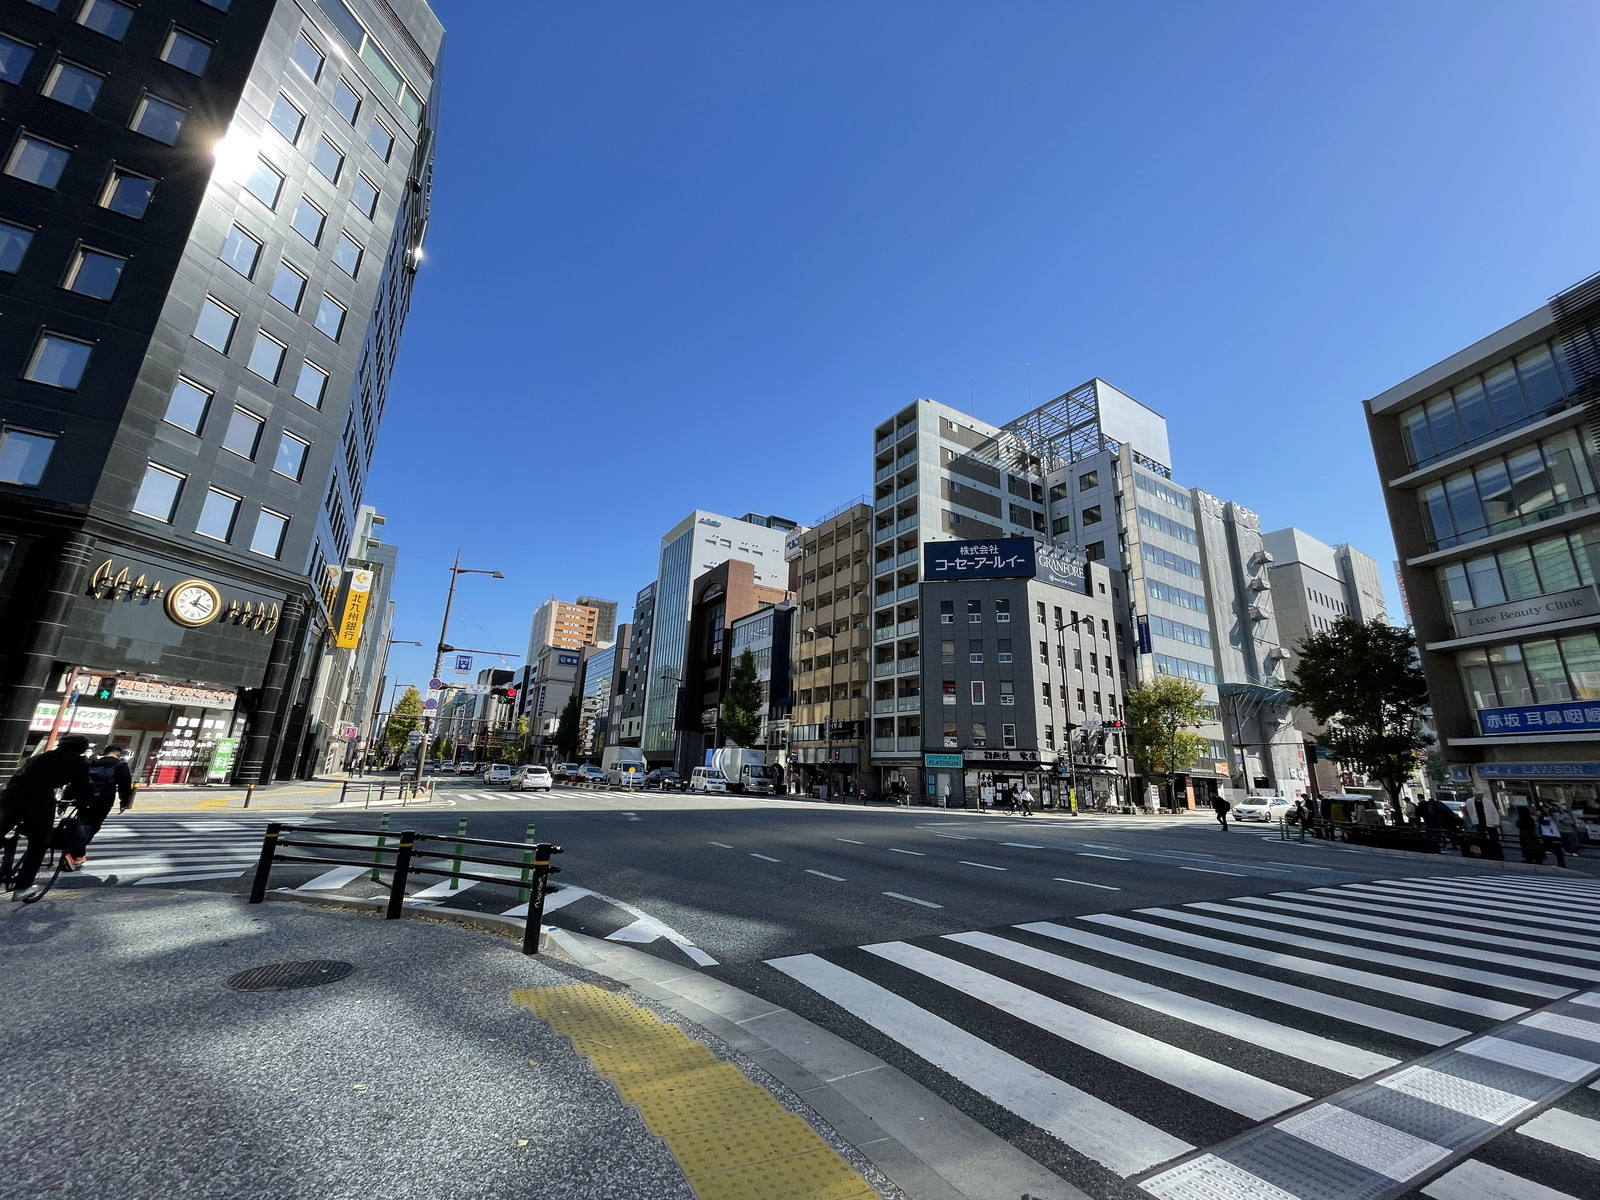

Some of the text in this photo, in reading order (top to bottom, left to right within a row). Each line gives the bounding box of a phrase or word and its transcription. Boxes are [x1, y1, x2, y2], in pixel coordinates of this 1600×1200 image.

[959, 544, 999, 556] 株式会社
[935, 555, 1026, 571] コーセーアールイー
[1038, 555, 1085, 579] GRANFORE
[343, 594, 364, 640] 北九州銀行
[1468, 597, 1586, 627] Luxe Beauty Clinic
[1522, 765, 1584, 775] LAWSON
